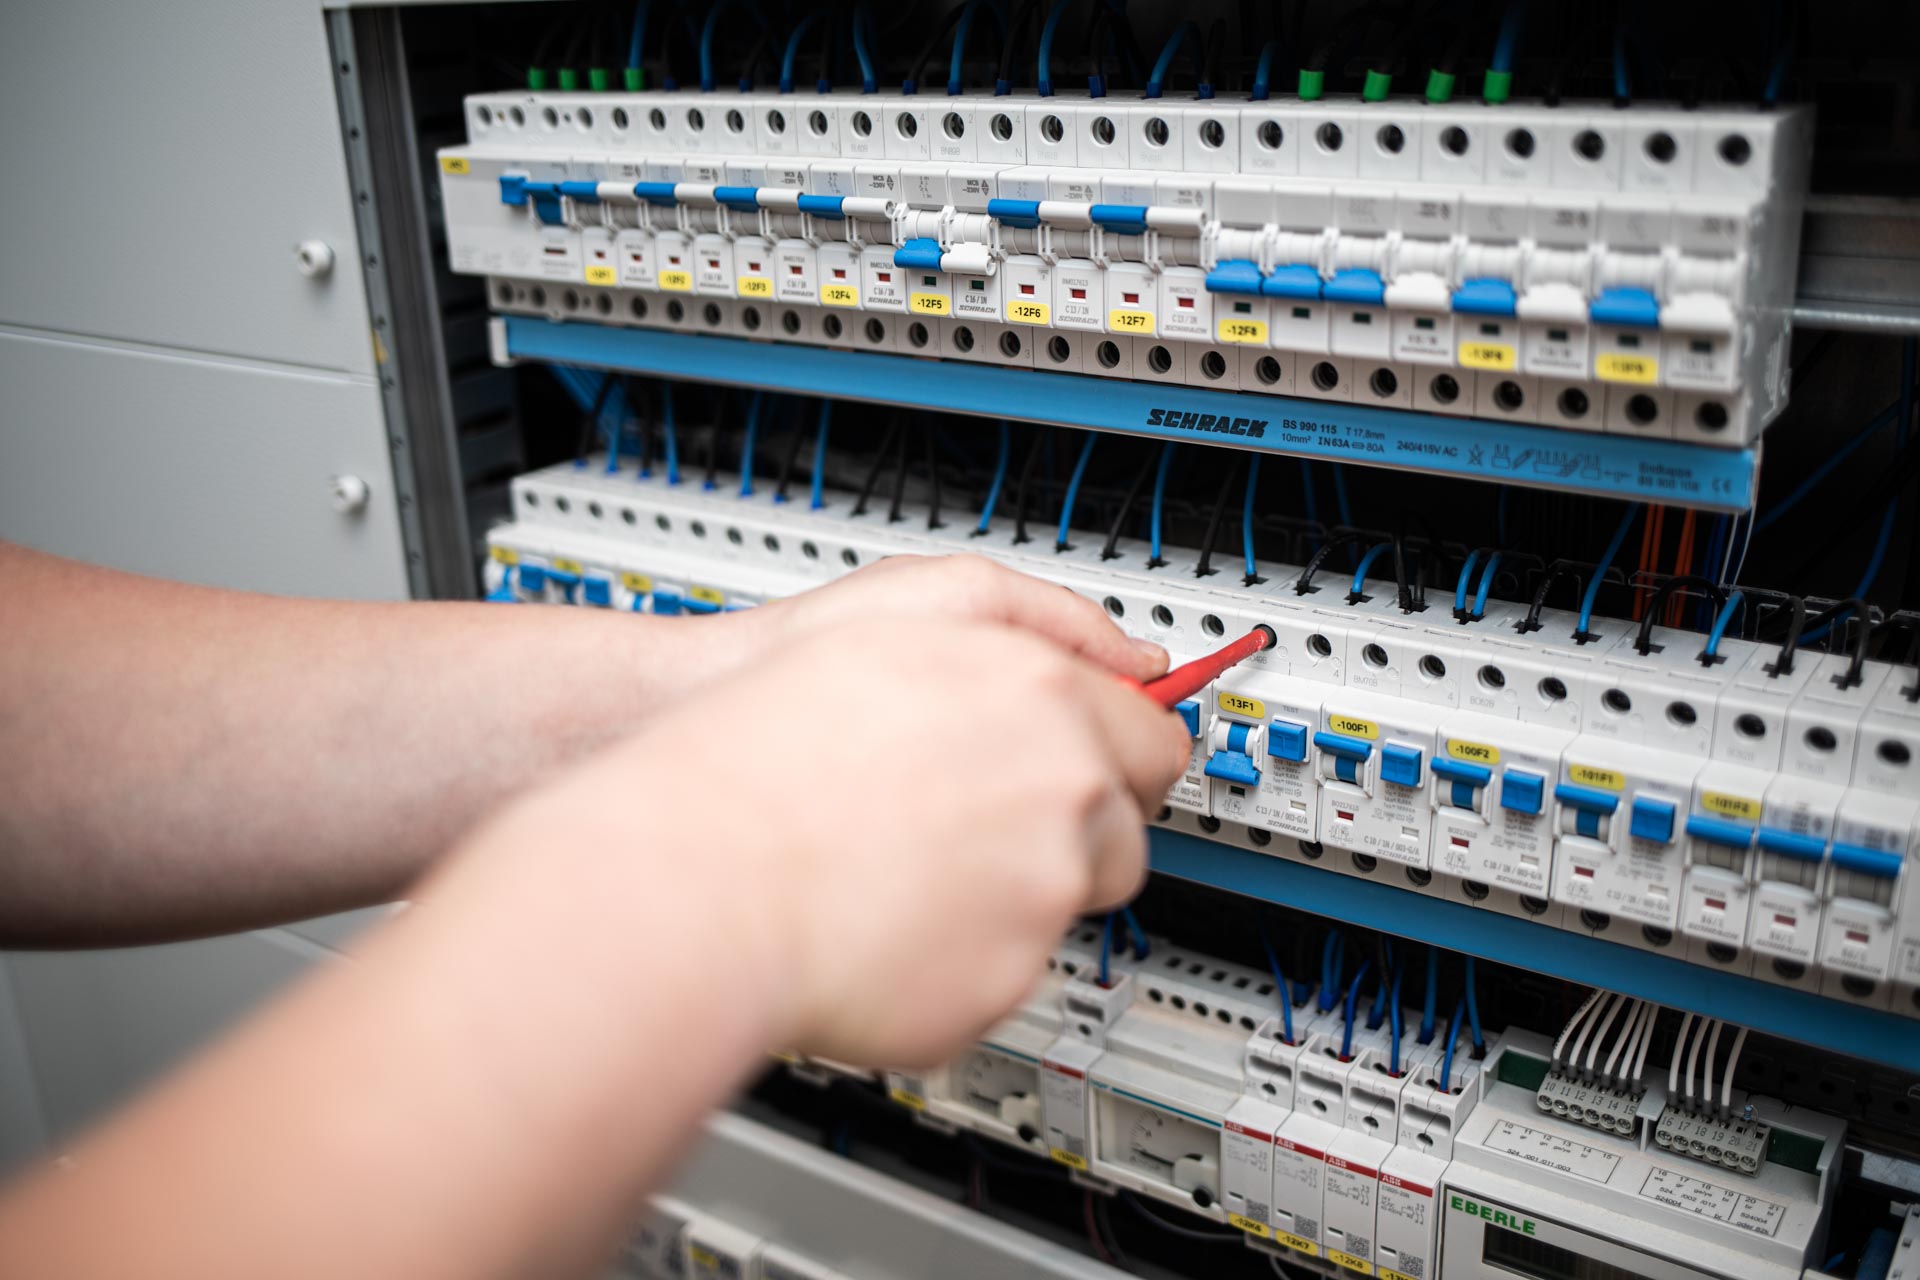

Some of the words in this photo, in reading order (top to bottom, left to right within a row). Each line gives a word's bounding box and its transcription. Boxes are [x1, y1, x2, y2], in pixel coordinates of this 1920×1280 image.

[827, 290, 851, 300] -12F4
[917, 298, 942, 309] -12F5
[958, 304, 997, 314] SCHRACK
[1014, 306, 1041, 318] -12F6
[1058, 315, 1099, 324] SCHRACK
[1117, 315, 1146, 326] -12F7
[1146, 408, 1269, 438] SCHRACK
[1282, 419, 1297, 429] BS
[1299, 420, 1317, 432] 990
[1321, 422, 1337, 434] 115
[1366, 442, 1385, 453] 80A
[1397, 440, 1440, 455] 240/415V
[1442, 446, 1458, 457] AC
[1226, 698, 1254, 711] -13F1
[1282, 705, 1299, 714] TEST
[1336, 720, 1368, 734] -100F1
[1455, 744, 1490, 759] -100F2
[1266, 819, 1309, 835] SCHRACK
[1375, 849, 1421, 864] SCHRACK
[1544, 1082, 1555, 1091] 10
[1560, 1087, 1571, 1097] 11
[1574, 1090, 1587, 1100] 12
[1591, 1095, 1602, 1106] 13
[1607, 1100, 1618, 1110] 14
[1623, 1104, 1636, 1115] 15
[1435, 1104, 1441, 1113] 3
[1400, 1129, 1412, 1140] A1
[1662, 1115, 1674, 1127] 16
[1677, 1120, 1690, 1131] 17
[1694, 1125, 1708, 1137] 18
[1711, 1130, 1725, 1142] 19
[1728, 1136, 1741, 1147] 20
[1745, 1141, 1758, 1153] 21
[1276, 1137, 1295, 1150] ABB
[1582, 1146, 1592, 1154] 14
[1328, 1156, 1347, 1168] ABB
[1382, 1174, 1401, 1186] ABB
[1724, 1190, 1734, 1198] 19
[1768, 1204, 1779, 1212] 21
[1451, 1195, 1536, 1236] EBERLE
[1740, 1212, 1768, 1225] 524004
[1283, 1236, 1310, 1250] -12K7
